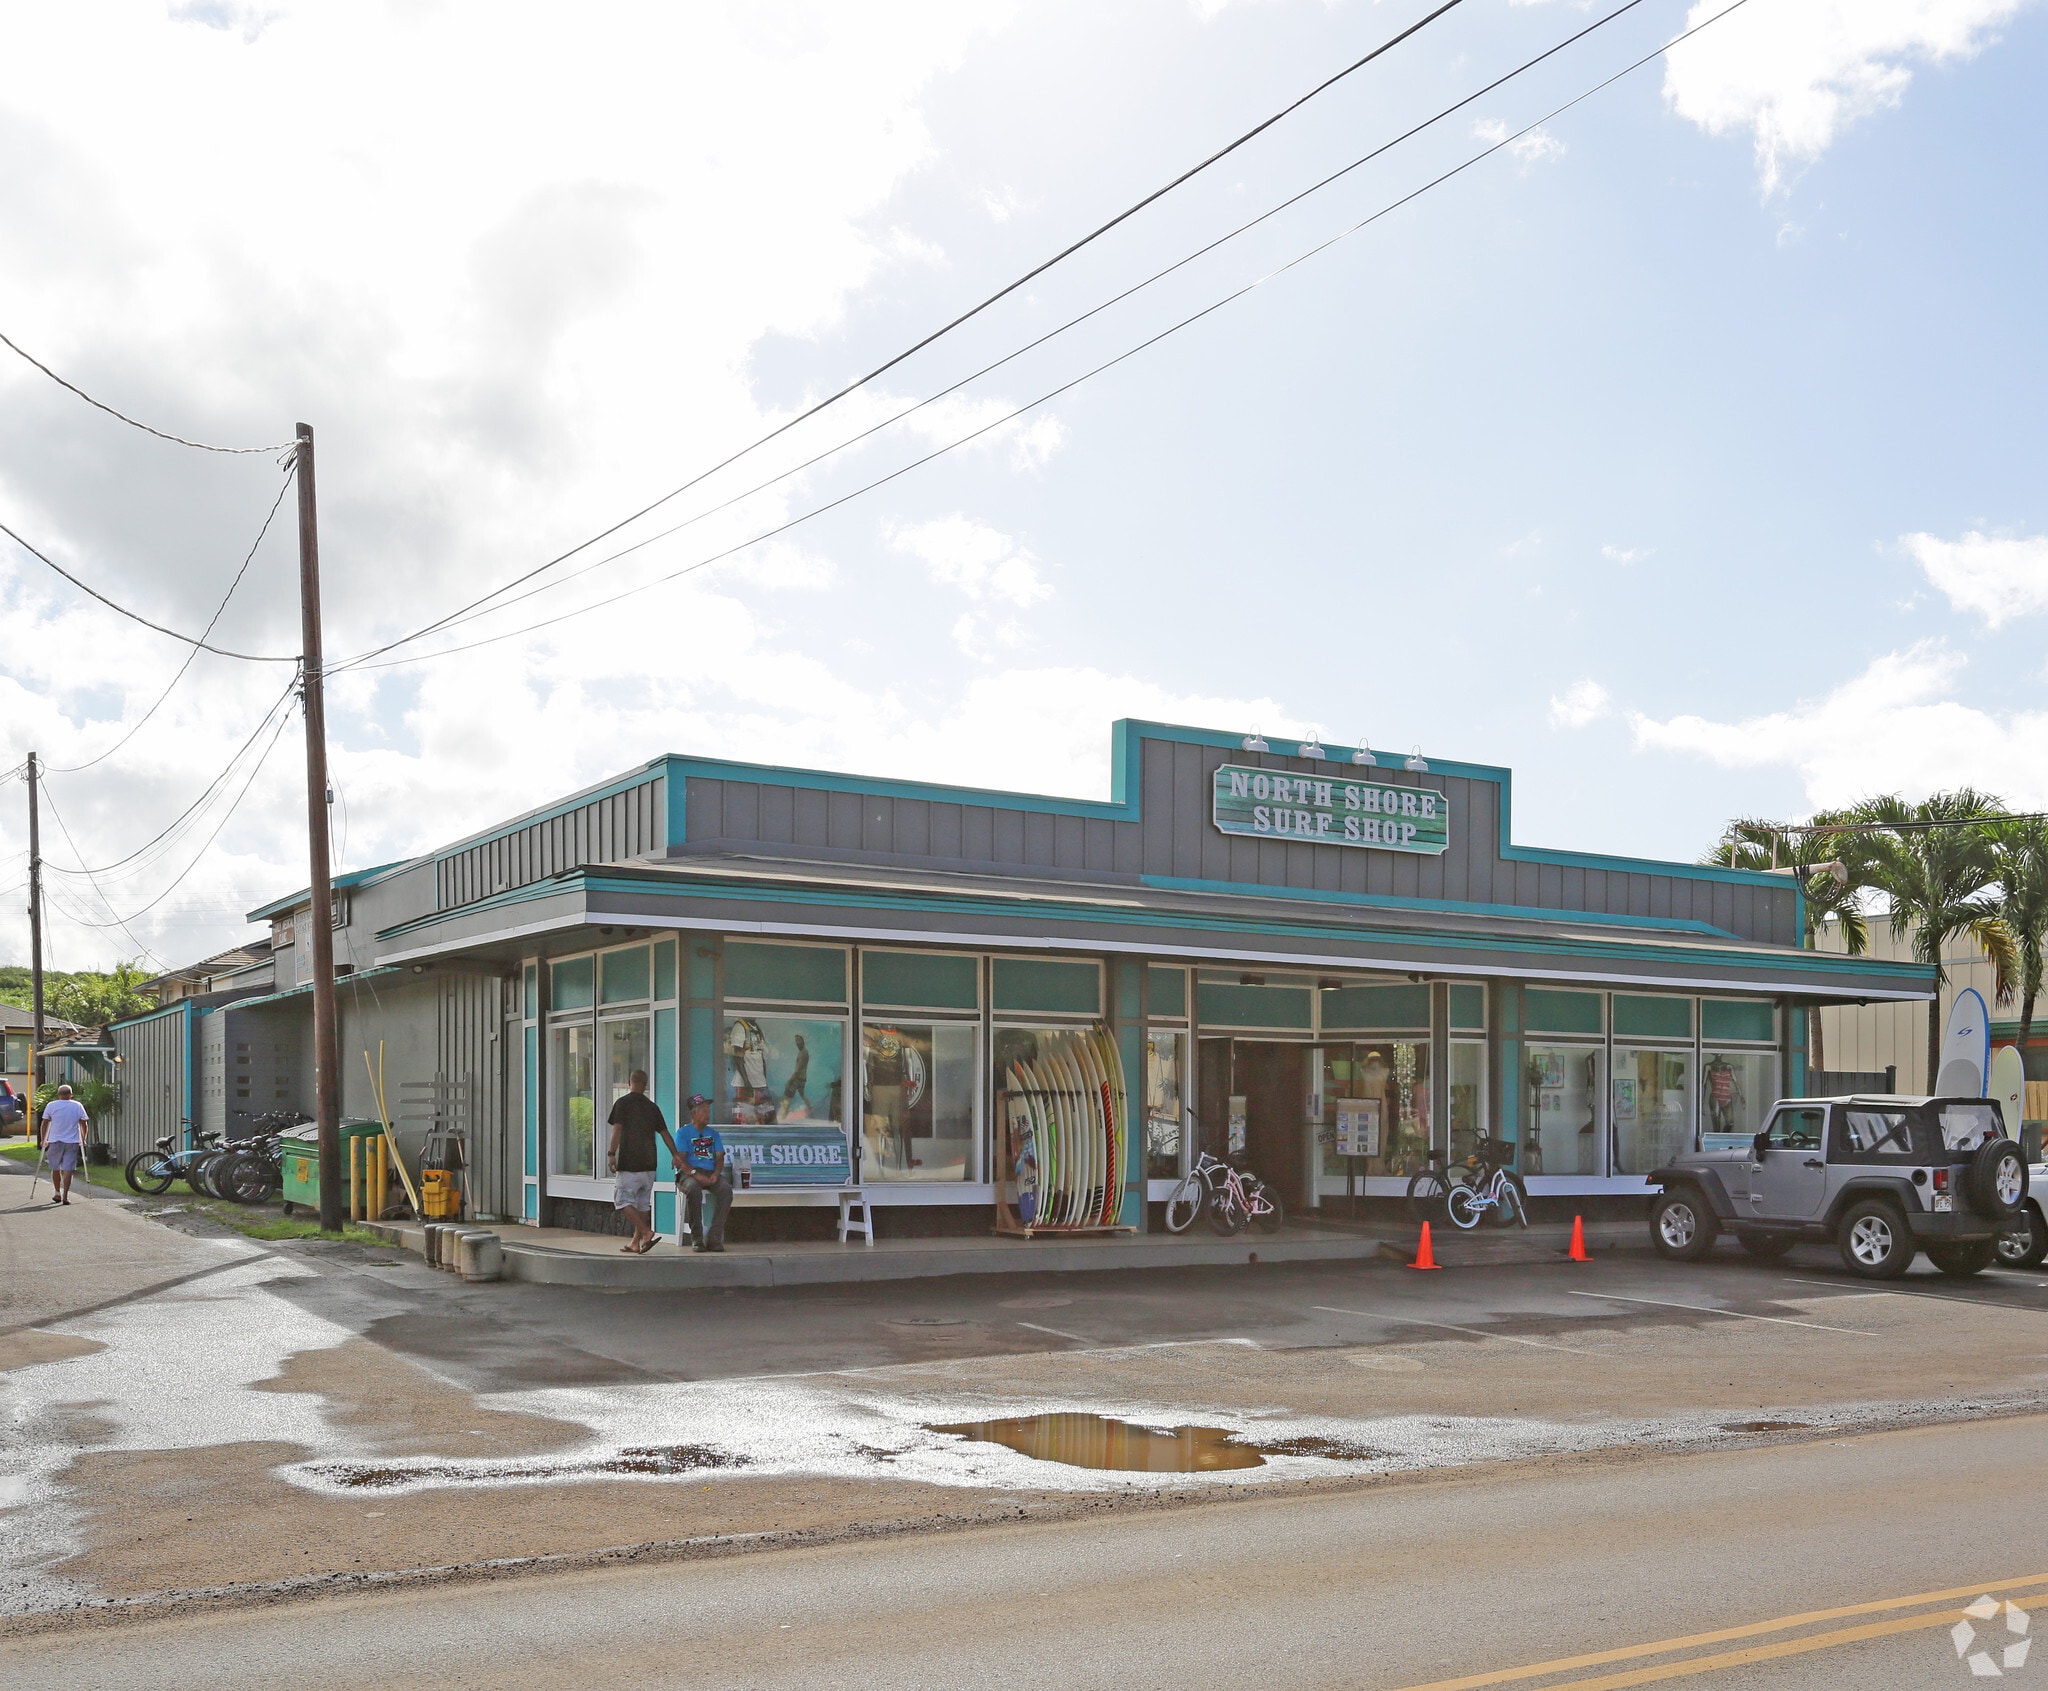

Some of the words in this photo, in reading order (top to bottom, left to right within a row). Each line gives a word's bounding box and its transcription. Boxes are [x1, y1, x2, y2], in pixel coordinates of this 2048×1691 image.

[1229, 772, 1333, 807] NORTH
[1345, 785, 1436, 820] SHORE
[1253, 806, 1333, 837] SURF
[1344, 815, 1417, 846] SHOP
[723, 1144, 766, 1164] RTH
[770, 1144, 842, 1164] SHORE
